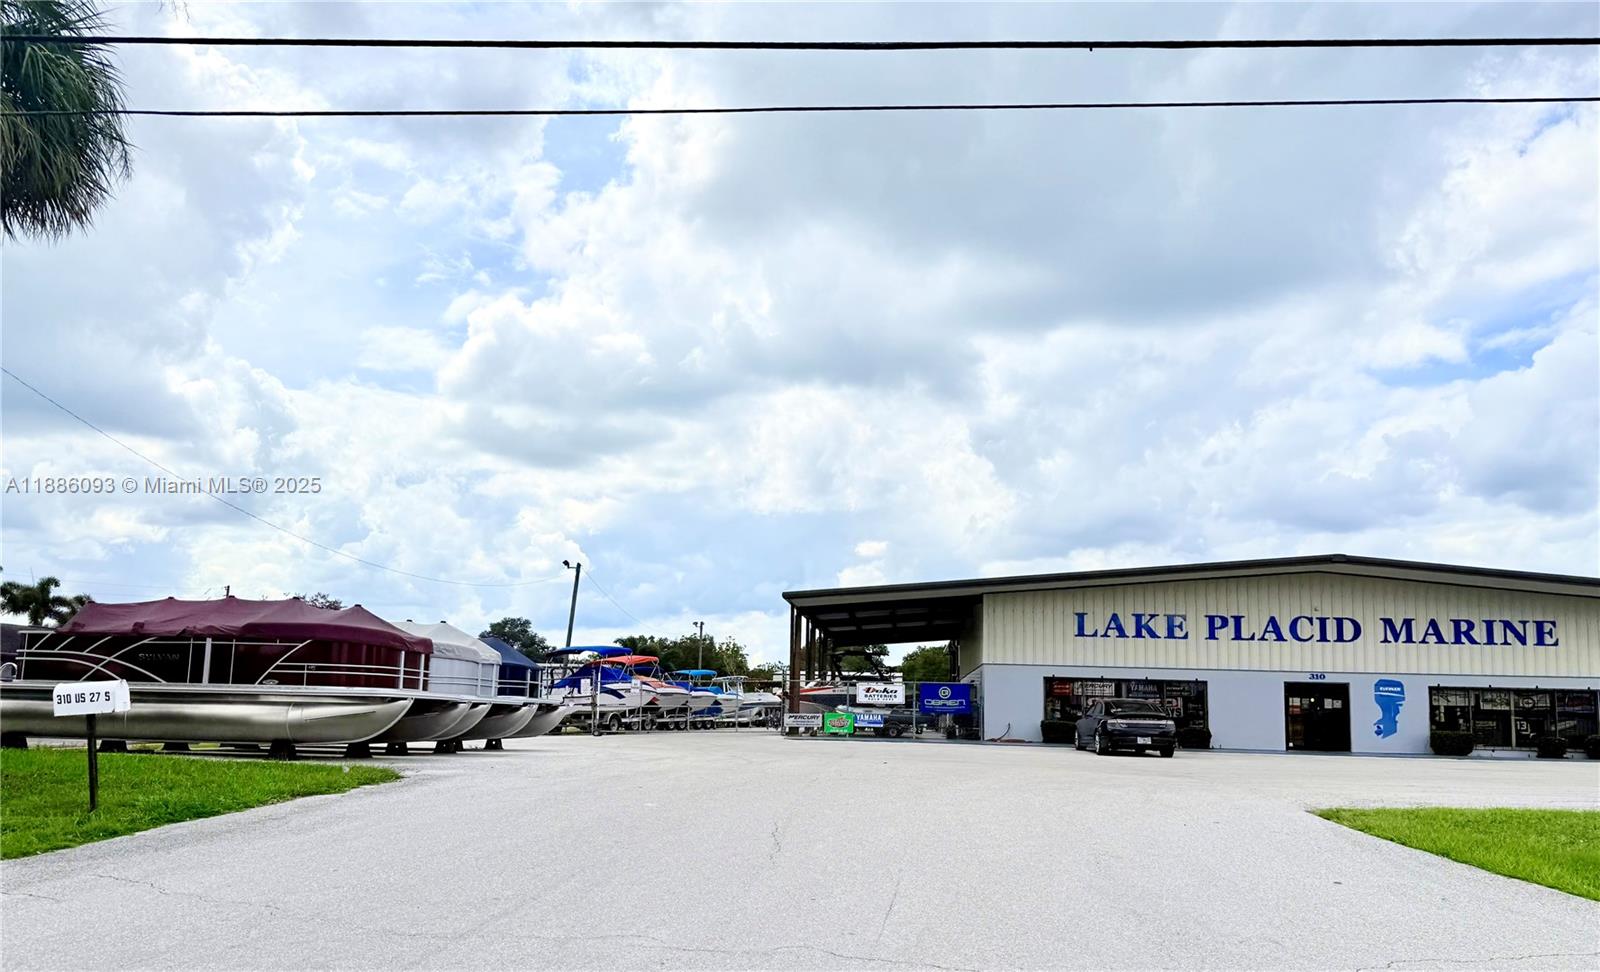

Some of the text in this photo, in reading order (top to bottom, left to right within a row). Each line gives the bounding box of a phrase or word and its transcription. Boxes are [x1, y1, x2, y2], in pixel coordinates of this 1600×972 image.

[1074, 612, 1560, 647] LAKE PLACID MARINE
[56, 691, 111, 705] 310 US 27 S
[856, 713, 882, 721] YAMAHA
[1516, 720, 1527, 730] 13
